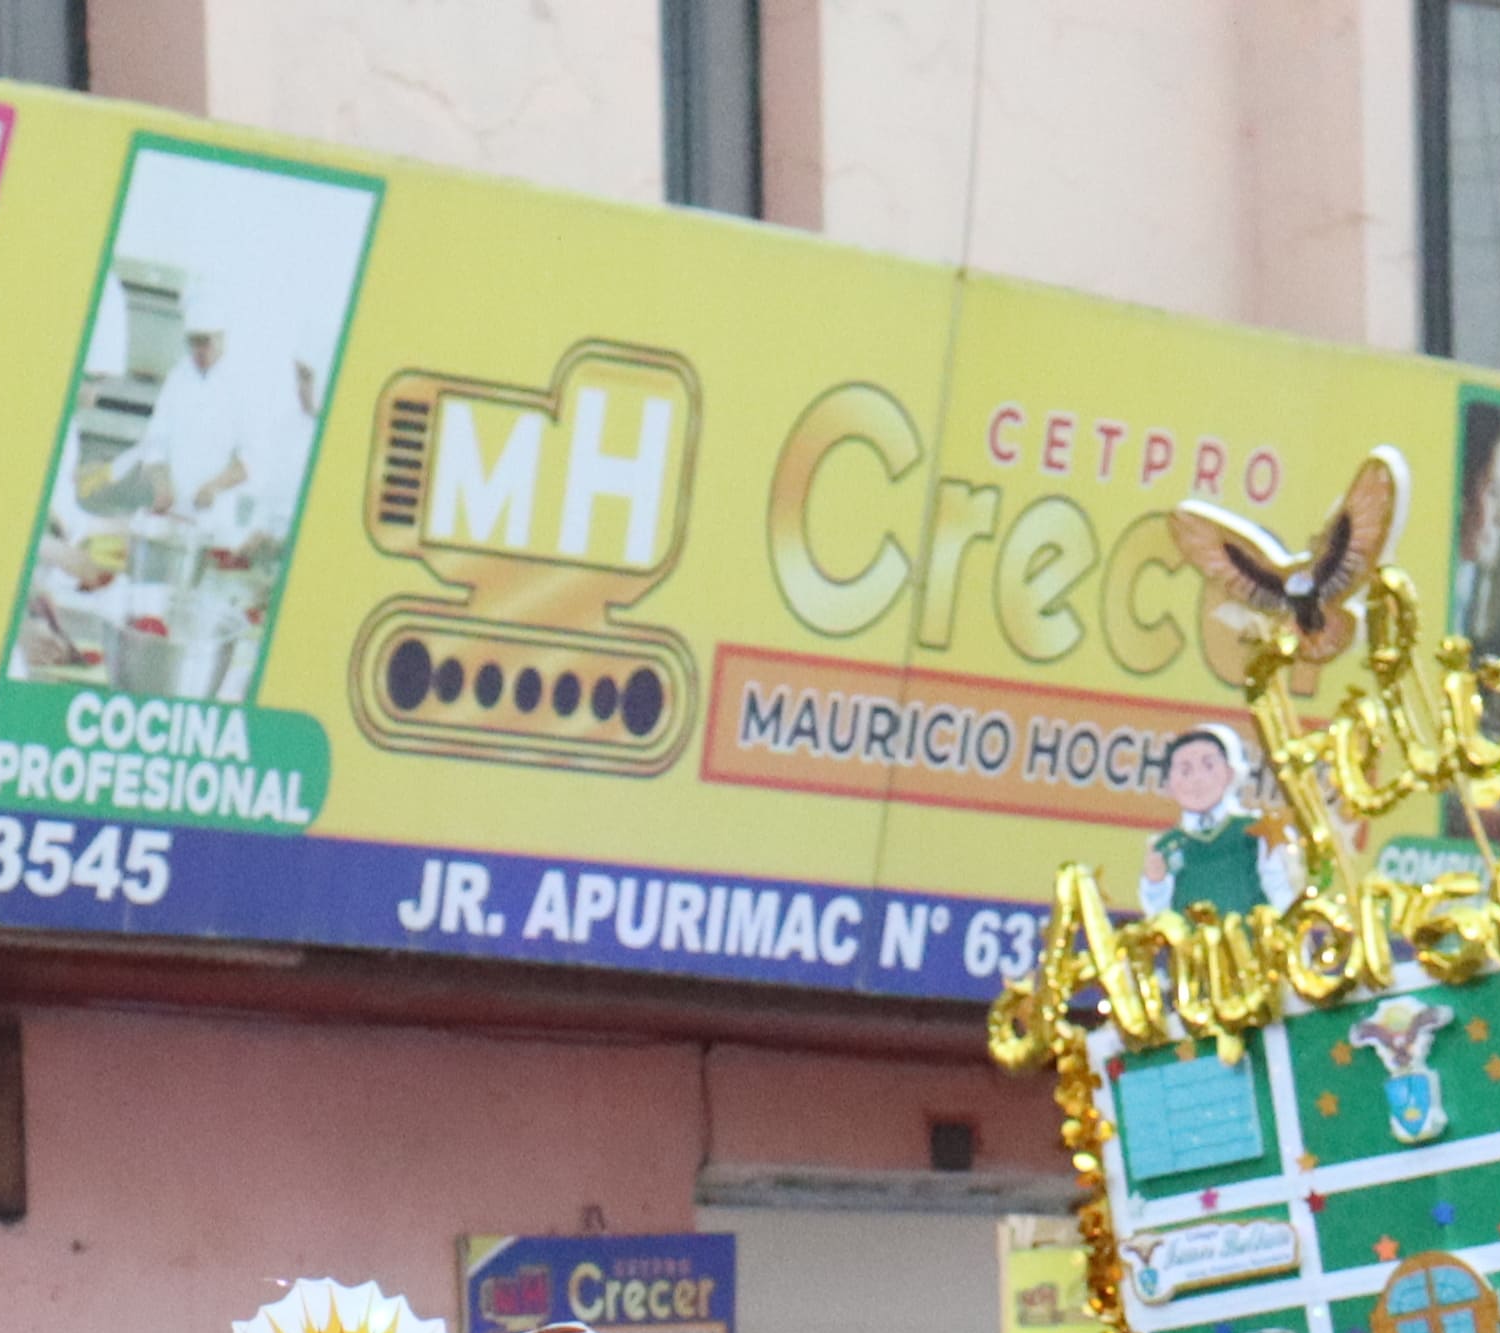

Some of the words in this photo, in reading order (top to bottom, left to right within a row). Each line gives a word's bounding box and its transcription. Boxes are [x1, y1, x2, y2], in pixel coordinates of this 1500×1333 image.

[425, 387, 672, 566] MH
[988, 406, 1283, 506] CETPRO
[66, 692, 250, 762] COCINA
[738, 687, 1012, 773] MAURICIO
[399, 862, 506, 938] JR.
[528, 868, 861, 964] APURIMAC
[964, 905, 1050, 980] 63
[568, 1262, 717, 1322] Crecer
